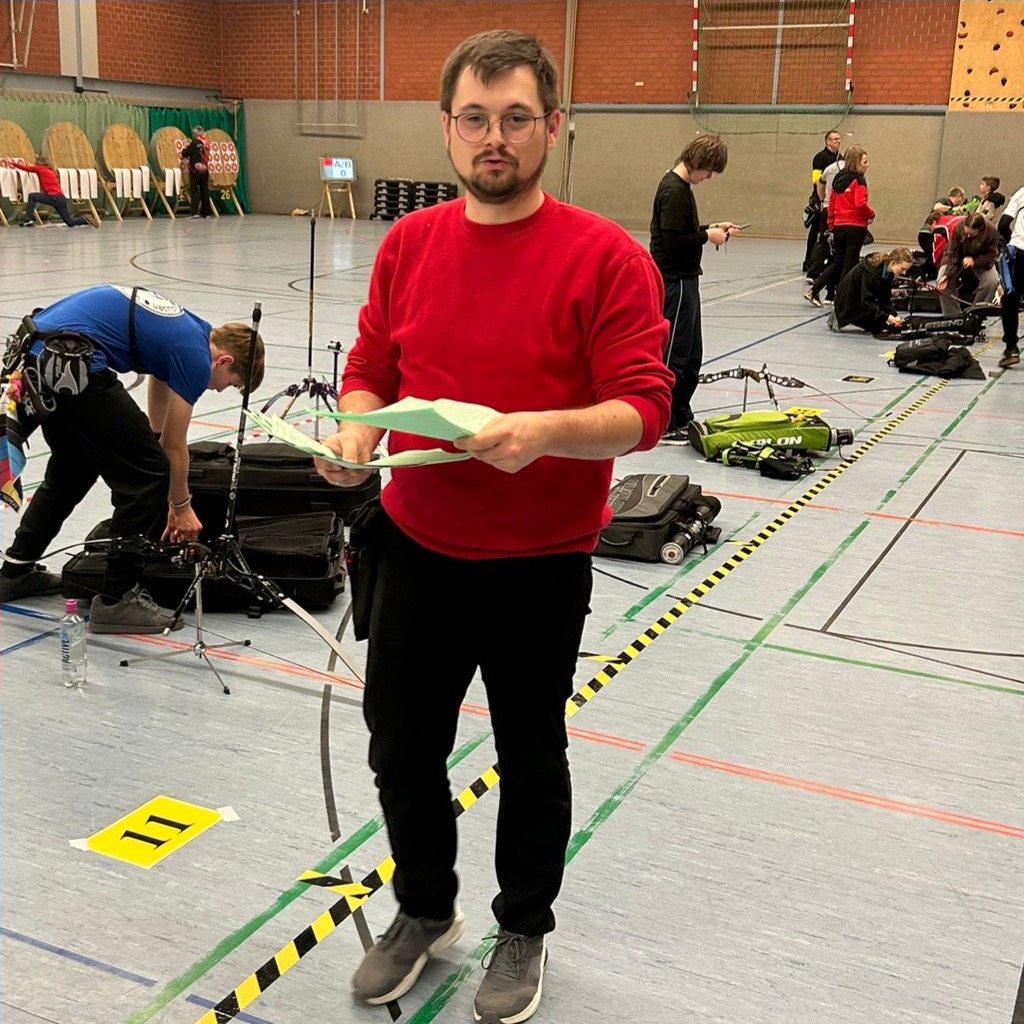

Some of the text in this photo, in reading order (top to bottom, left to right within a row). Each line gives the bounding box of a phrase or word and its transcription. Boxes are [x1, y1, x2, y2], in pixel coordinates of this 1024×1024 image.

[334, 160, 352, 169] A/B
[340, 169, 347, 177] 0
[220, 189, 231, 201] 26
[919, 319, 964, 330] LEGEND
[119, 814, 196, 851] 11
